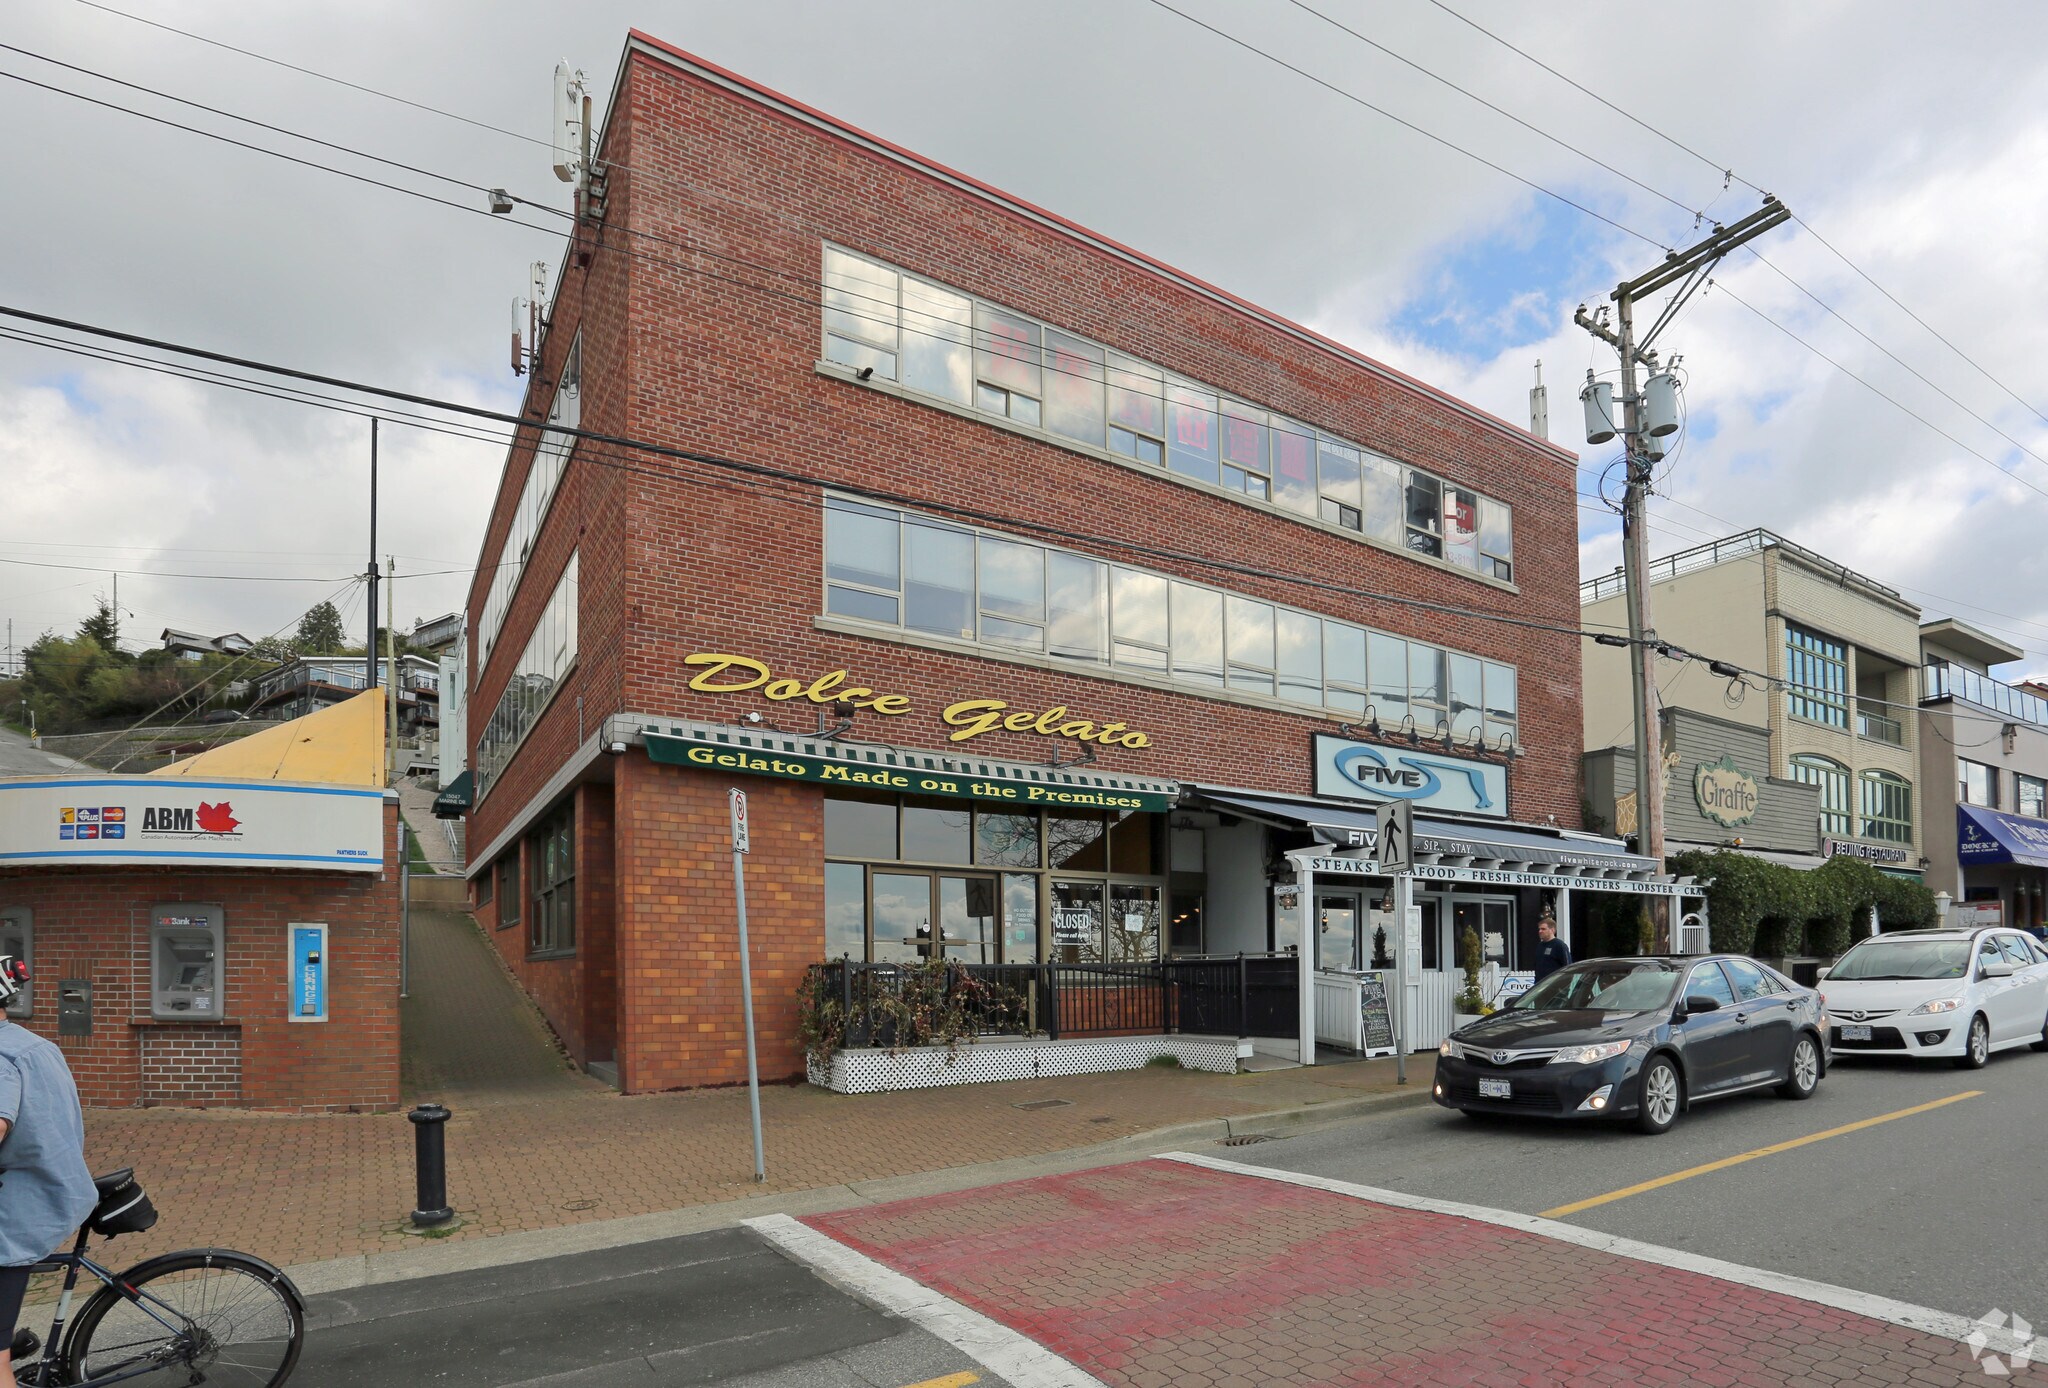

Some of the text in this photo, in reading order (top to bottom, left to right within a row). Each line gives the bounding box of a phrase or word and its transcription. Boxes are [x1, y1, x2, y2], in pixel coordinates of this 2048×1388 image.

[684, 653, 1152, 749] Dolce Gelato
[687, 747, 1142, 808] Gelato Made on the Premises
[1358, 764, 1421, 788] FIVE
[1702, 775, 1755, 812] Giraffe
[142, 807, 193, 830] ABM
[1348, 831, 1378, 847] FIV
[1450, 842, 1474, 854] STAY.
[1836, 842, 1865, 857] BEIJING
[1560, 855, 1638, 869] fivewhiterock.com
[1312, 858, 1372, 873] STEAKS
[1401, 866, 1456, 879] AFOOD
[1472, 871, 1511, 882] FRESH
[1516, 874, 1570, 886] SHUCKED
[1575, 878, 1620, 890] OYSTERS
[1632, 882, 1674, 894] LOBSTER
[1055, 913, 1089, 929] CLOSED
[304, 965, 316, 1004] CHANGE
